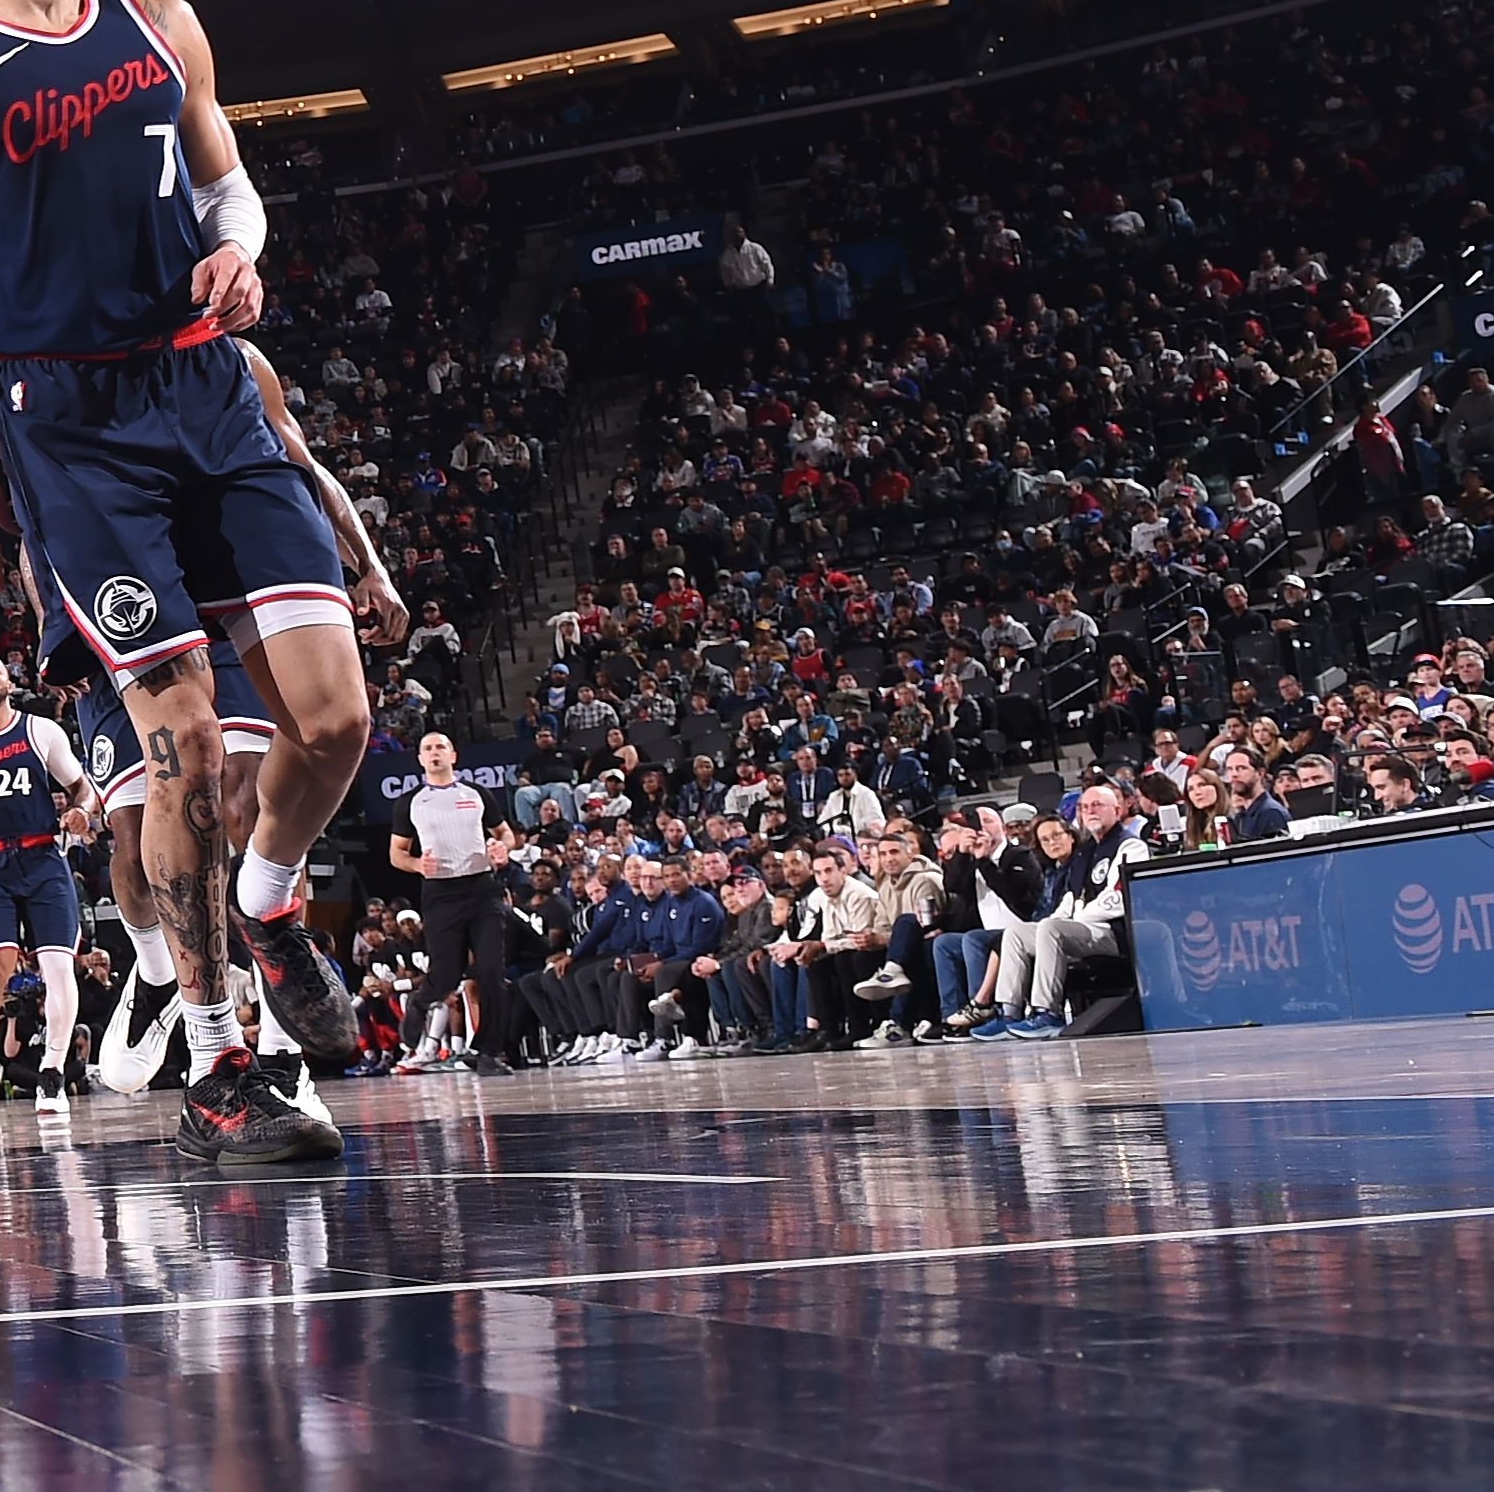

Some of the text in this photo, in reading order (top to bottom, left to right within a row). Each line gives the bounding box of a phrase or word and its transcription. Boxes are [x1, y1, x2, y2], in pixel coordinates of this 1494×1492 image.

[2, 51, 169, 165] Clippers
[143, 123, 176, 198] 7
[1228, 915, 1303, 973] AT&T
